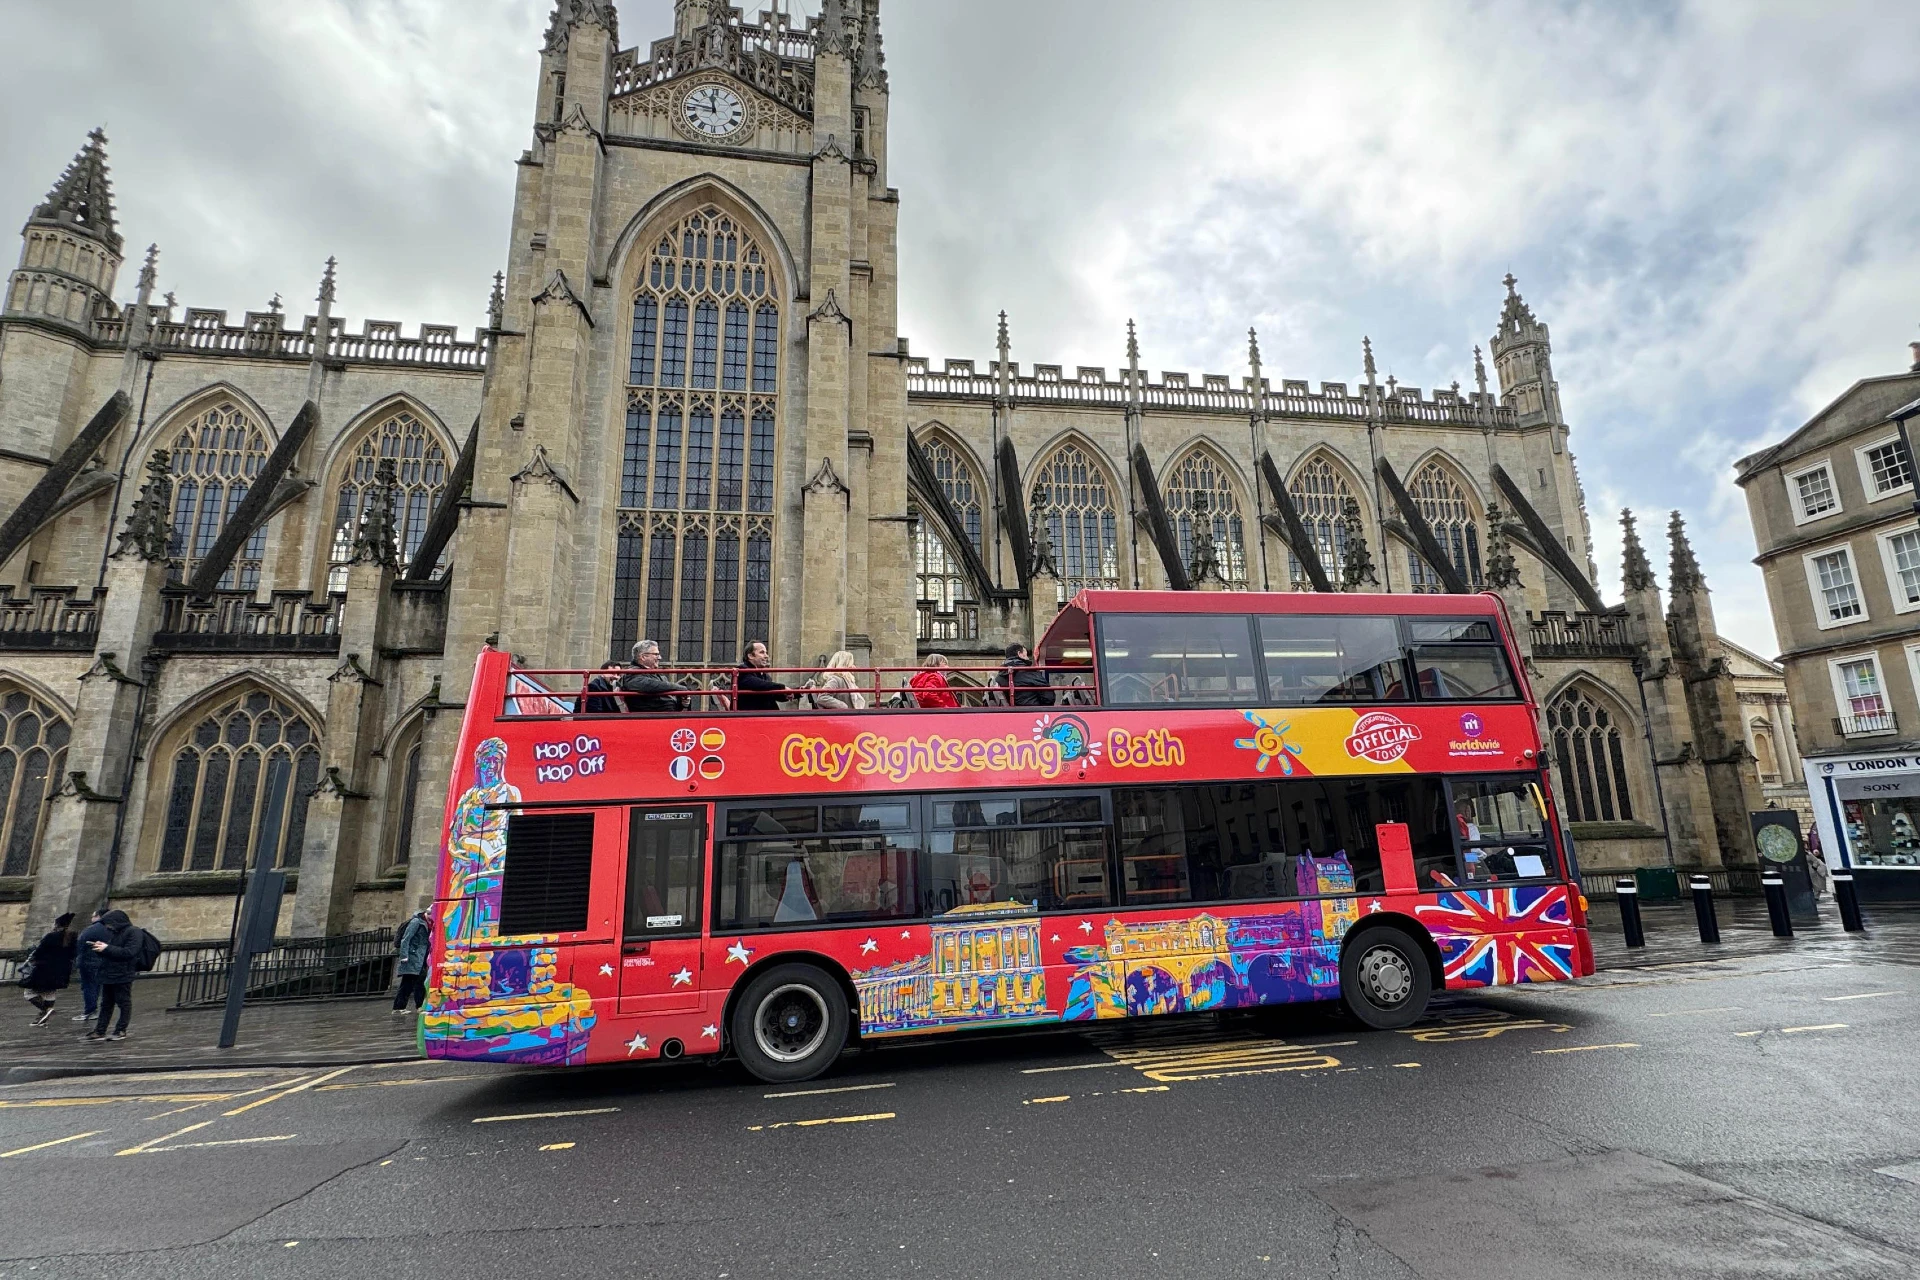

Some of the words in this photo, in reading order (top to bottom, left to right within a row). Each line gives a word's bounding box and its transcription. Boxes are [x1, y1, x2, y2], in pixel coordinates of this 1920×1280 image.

[535, 742, 571, 760] Hop
[575, 735, 600, 753] On
[1107, 728, 1186, 768] Bath
[1352, 726, 1418, 753] OFFICIAL
[1448, 739, 1500, 750] Worldwide
[1375, 744, 1404, 760] TOUR
[538, 764, 573, 782] Hop
[578, 755, 605, 775] Off
[1847, 758, 1907, 771] LONDON
[1863, 783, 1901, 792] SONY
